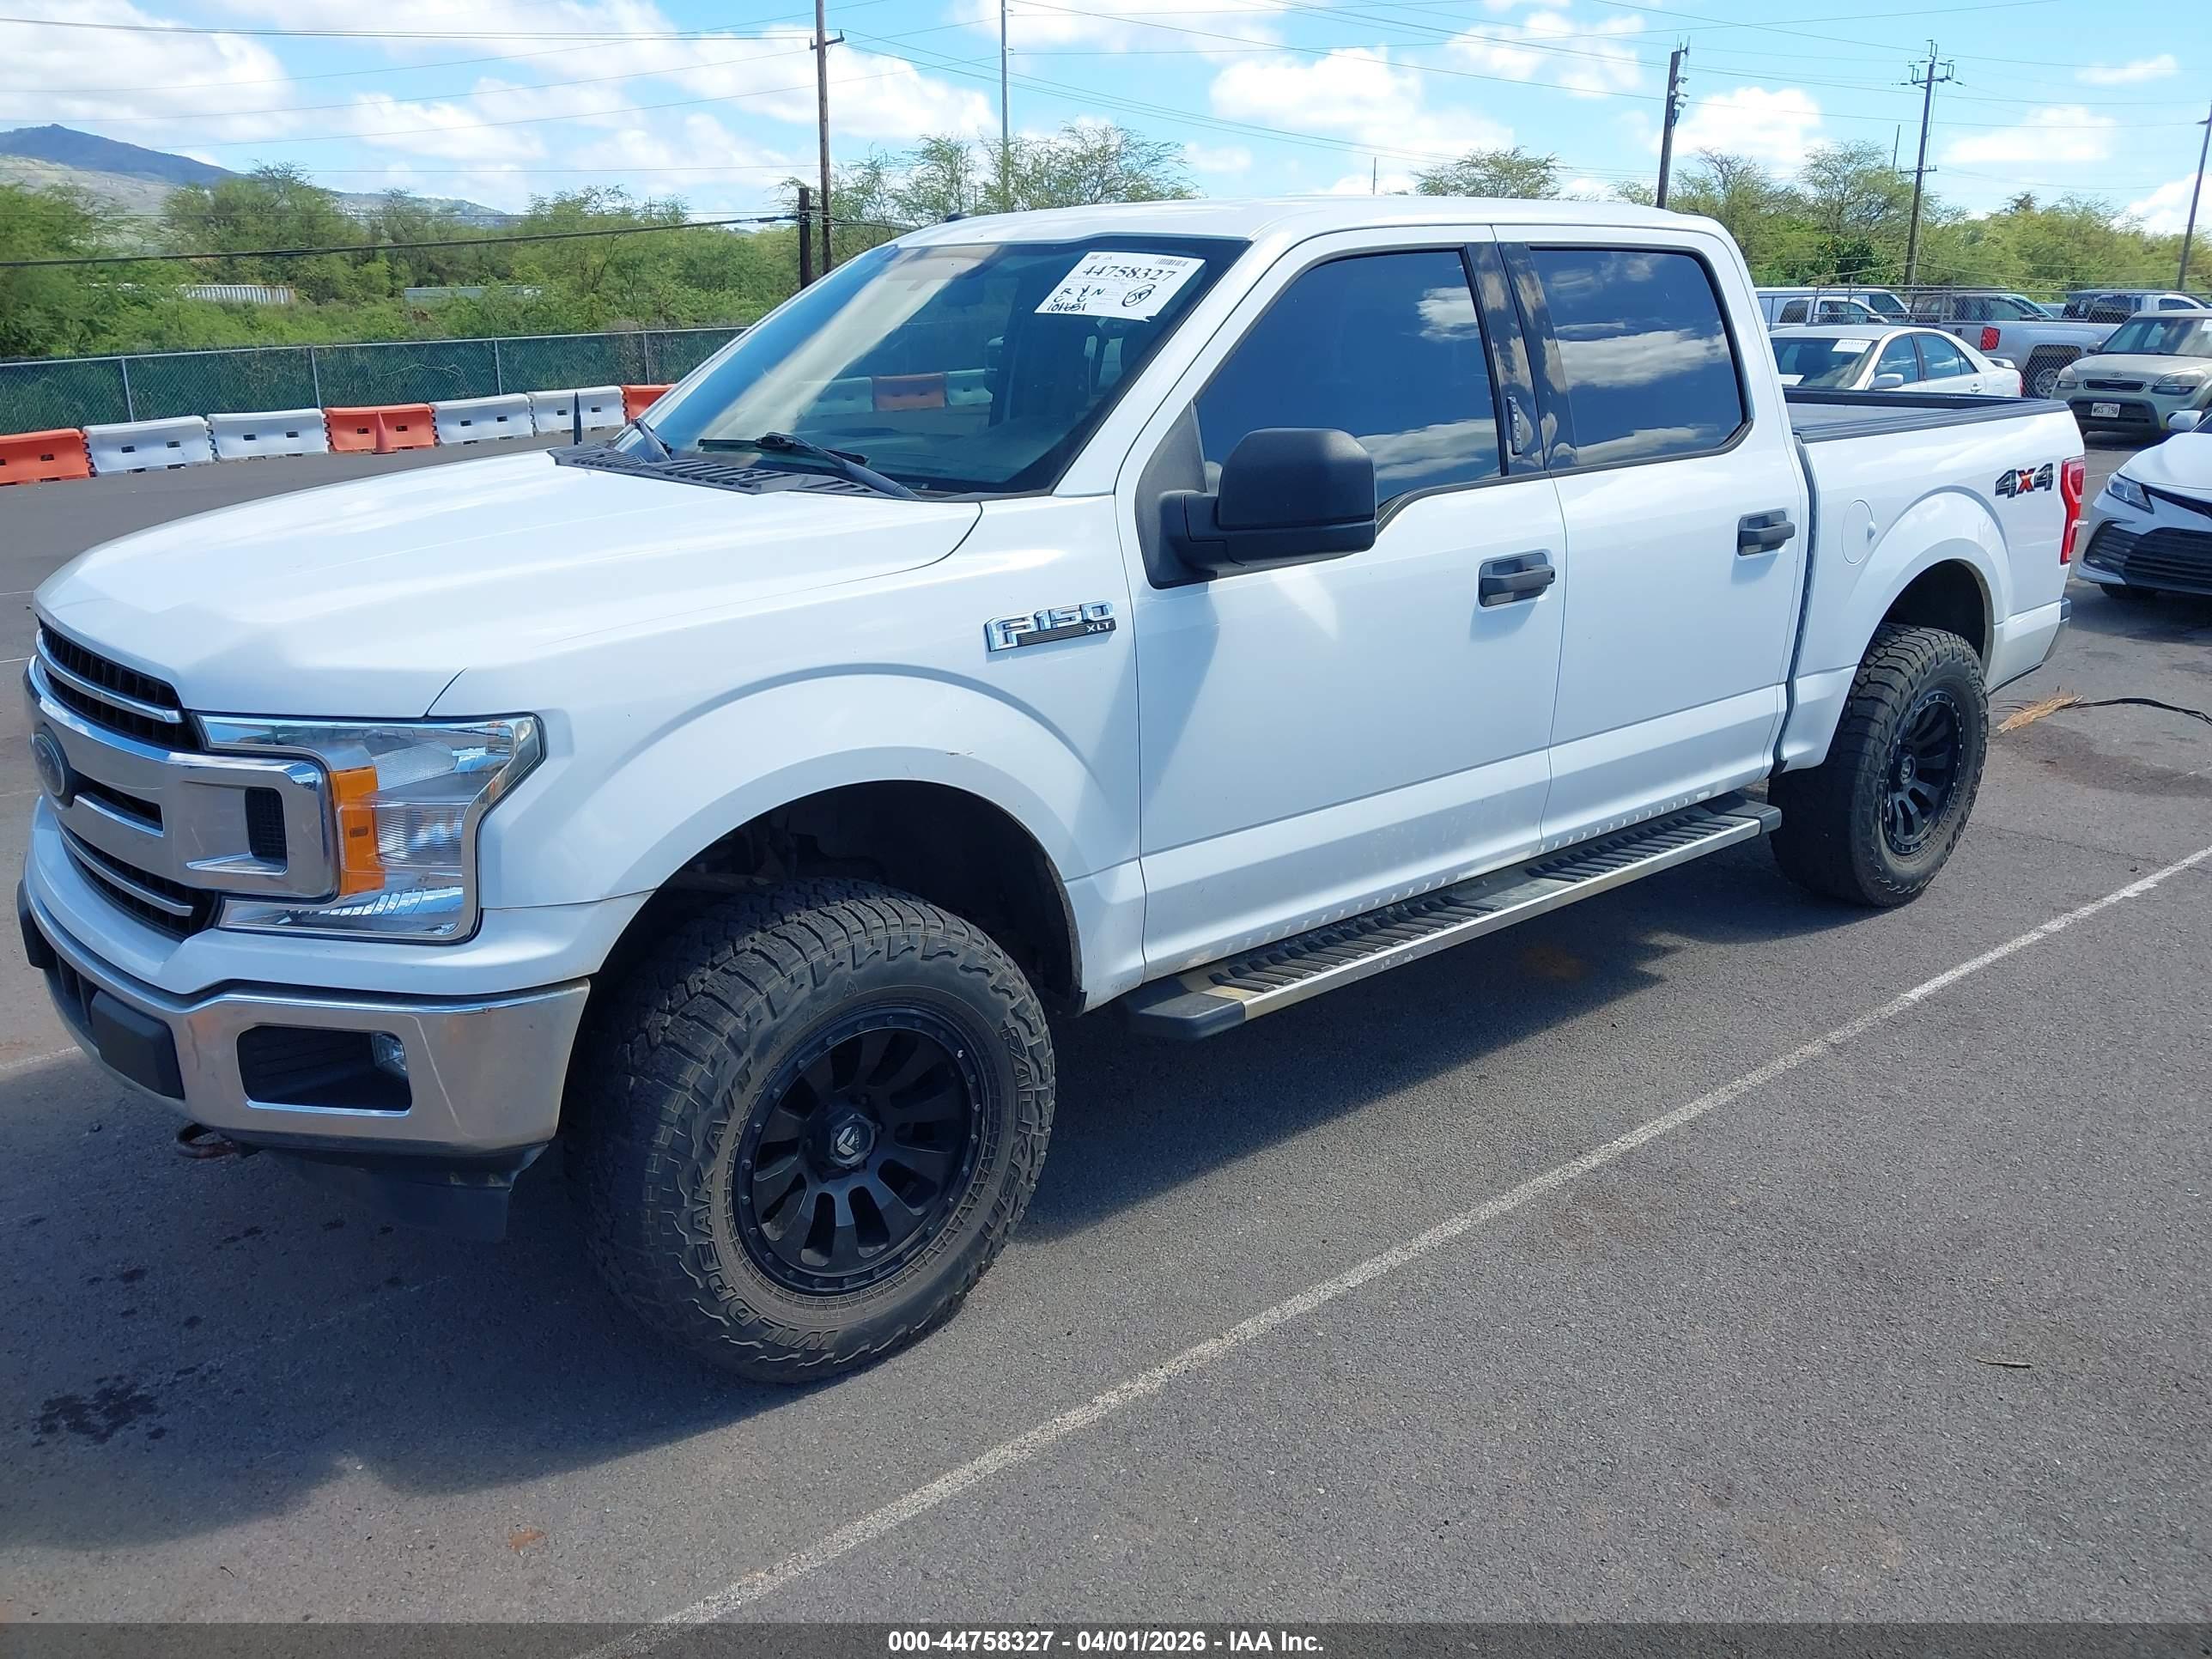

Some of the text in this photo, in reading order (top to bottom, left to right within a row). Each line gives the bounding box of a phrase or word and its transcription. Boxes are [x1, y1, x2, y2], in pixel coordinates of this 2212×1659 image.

[1082, 264, 1177, 282] 44758327
[1086, 621, 1113, 633] XLT
[694, 1163, 838, 1350] WILDPEAK
